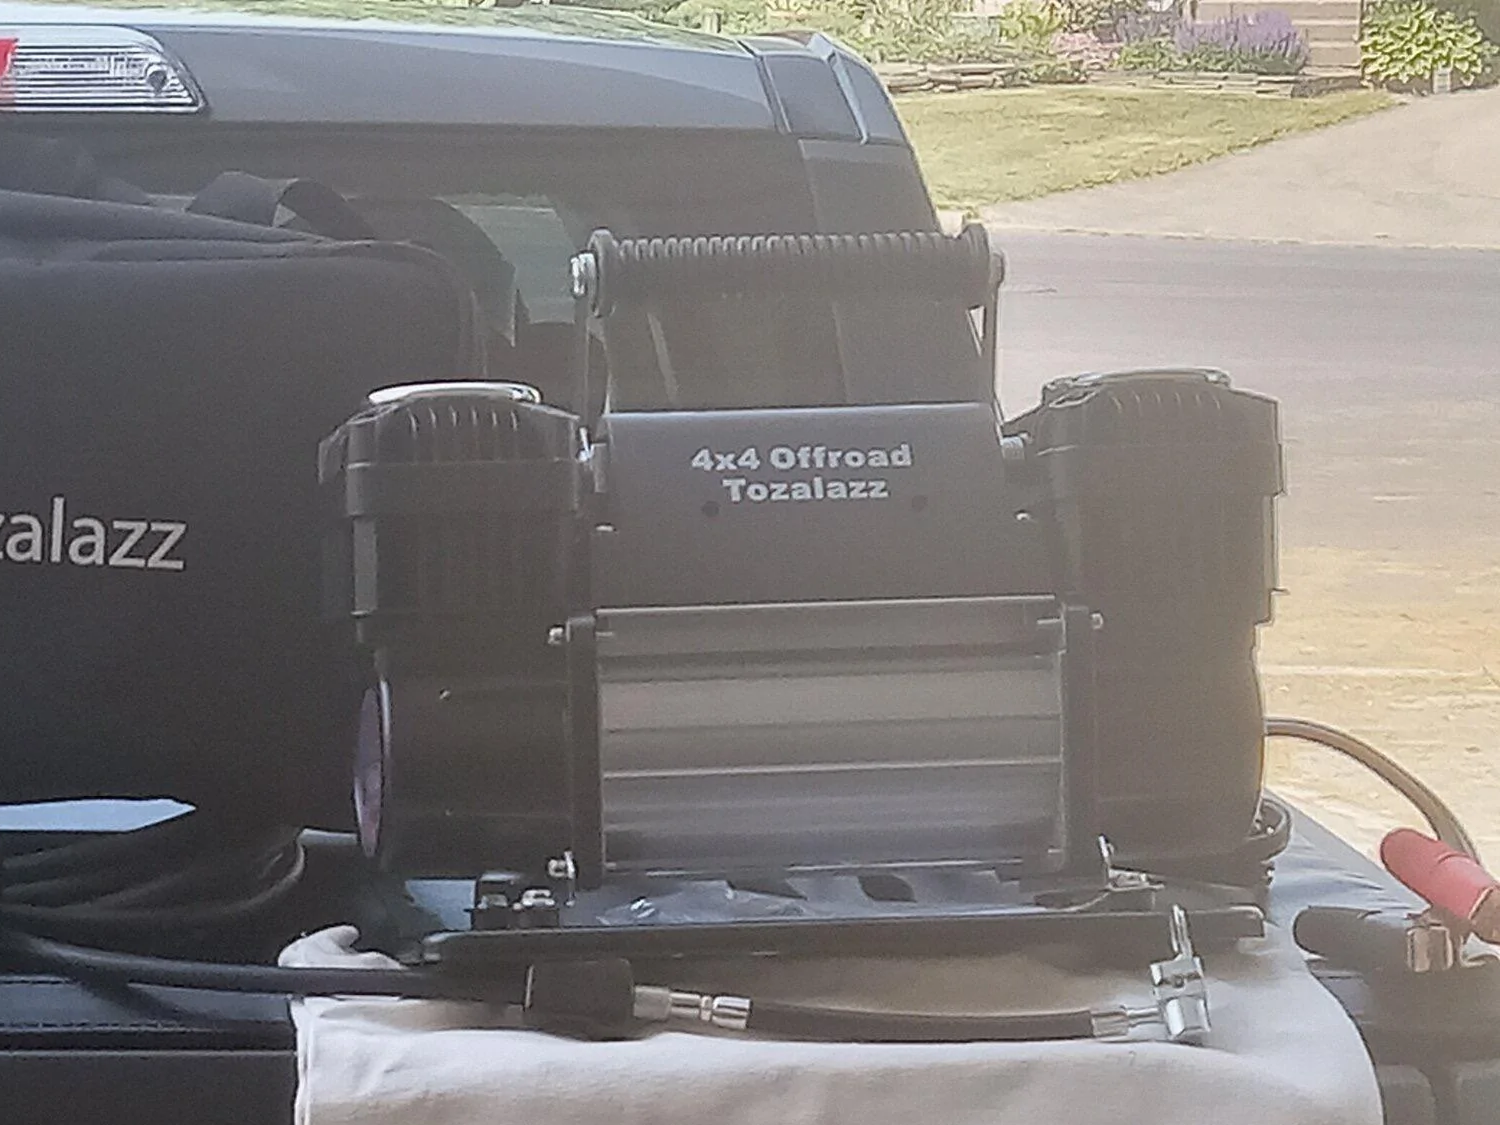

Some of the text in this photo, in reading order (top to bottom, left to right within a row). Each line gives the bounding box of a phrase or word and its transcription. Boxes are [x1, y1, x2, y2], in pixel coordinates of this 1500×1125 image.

[691, 444, 912, 471] 4x4 Offroad
[722, 476, 889, 502] Tozalazz
